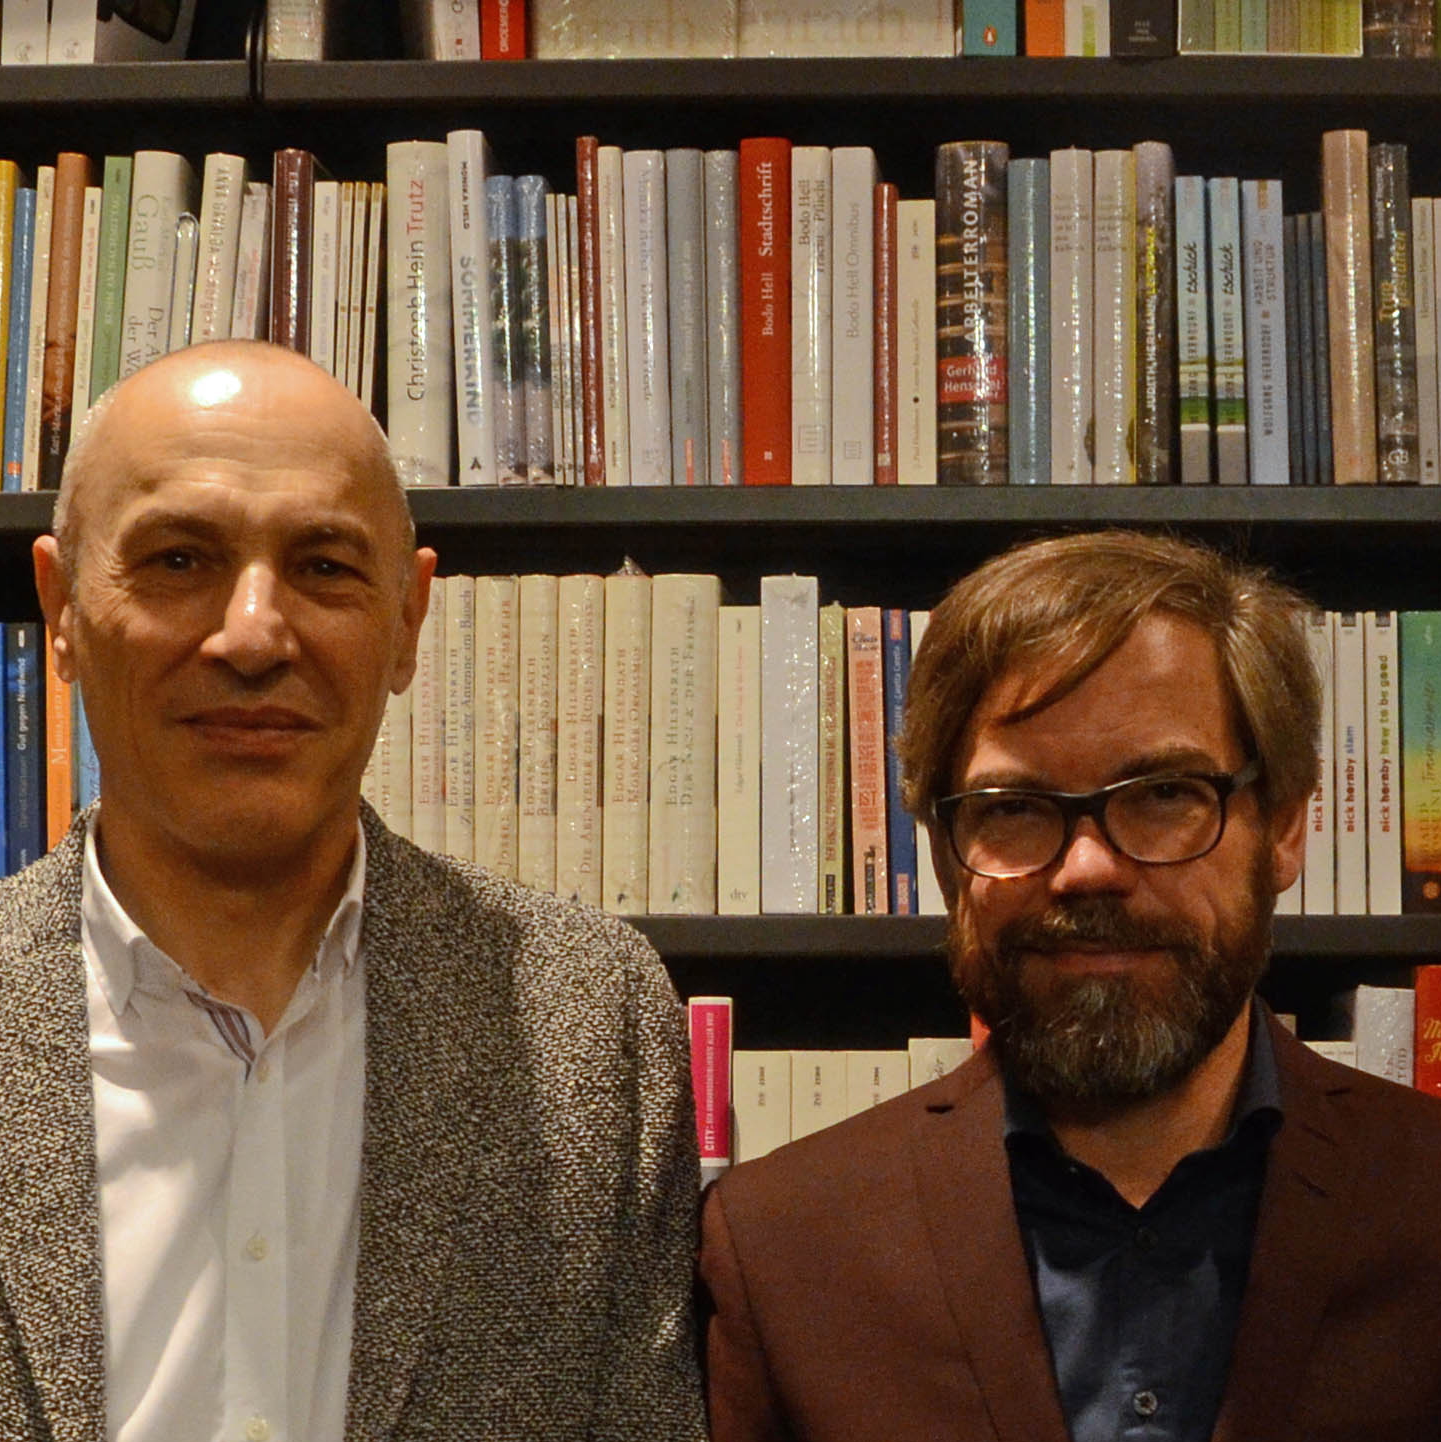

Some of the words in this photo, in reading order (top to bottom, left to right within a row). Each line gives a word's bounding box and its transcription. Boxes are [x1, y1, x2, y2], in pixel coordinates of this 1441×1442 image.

[406, 179, 424, 235] Trutz
[757, 161, 772, 257] Stadtschrift
[798, 179, 810, 207] Hell
[131, 194, 159, 271] Gauß
[798, 211, 810, 245] Bodo
[846, 202, 859, 266] Omnibus
[408, 241, 424, 290] Hein
[962, 160, 979, 343] ARBEITERROMAN
[1183, 242, 1197, 294] tschick
[1220, 242, 1234, 295] tschick
[761, 272, 774, 300] Hell
[846, 270, 859, 300] Hell
[460, 255, 483, 426] SOMMERKIND
[761, 304, 774, 336] Bodo
[846, 304, 859, 338] Bodo
[1147, 296, 1157, 360] HERMANN
[407, 297, 428, 401] Christoph
[1147, 363, 1157, 411] JUDITH
[461, 590, 472, 630] Bauch
[461, 634, 472, 650] im
[461, 654, 472, 709] Antenne
[1379, 655, 1391, 687] good
[667, 647, 679, 745] HILSENRATH
[1379, 690, 1391, 705] be
[1379, 709, 1391, 723] to
[461, 713, 472, 742] oder
[1345, 726, 1356, 755] slam
[1379, 727, 1391, 755] how
[667, 755, 679, 806] EDGAR
[1345, 758, 1356, 802] hornby
[1379, 758, 1391, 802] hornby
[1345, 806, 1356, 832] nick
[1379, 806, 1391, 832] nick
